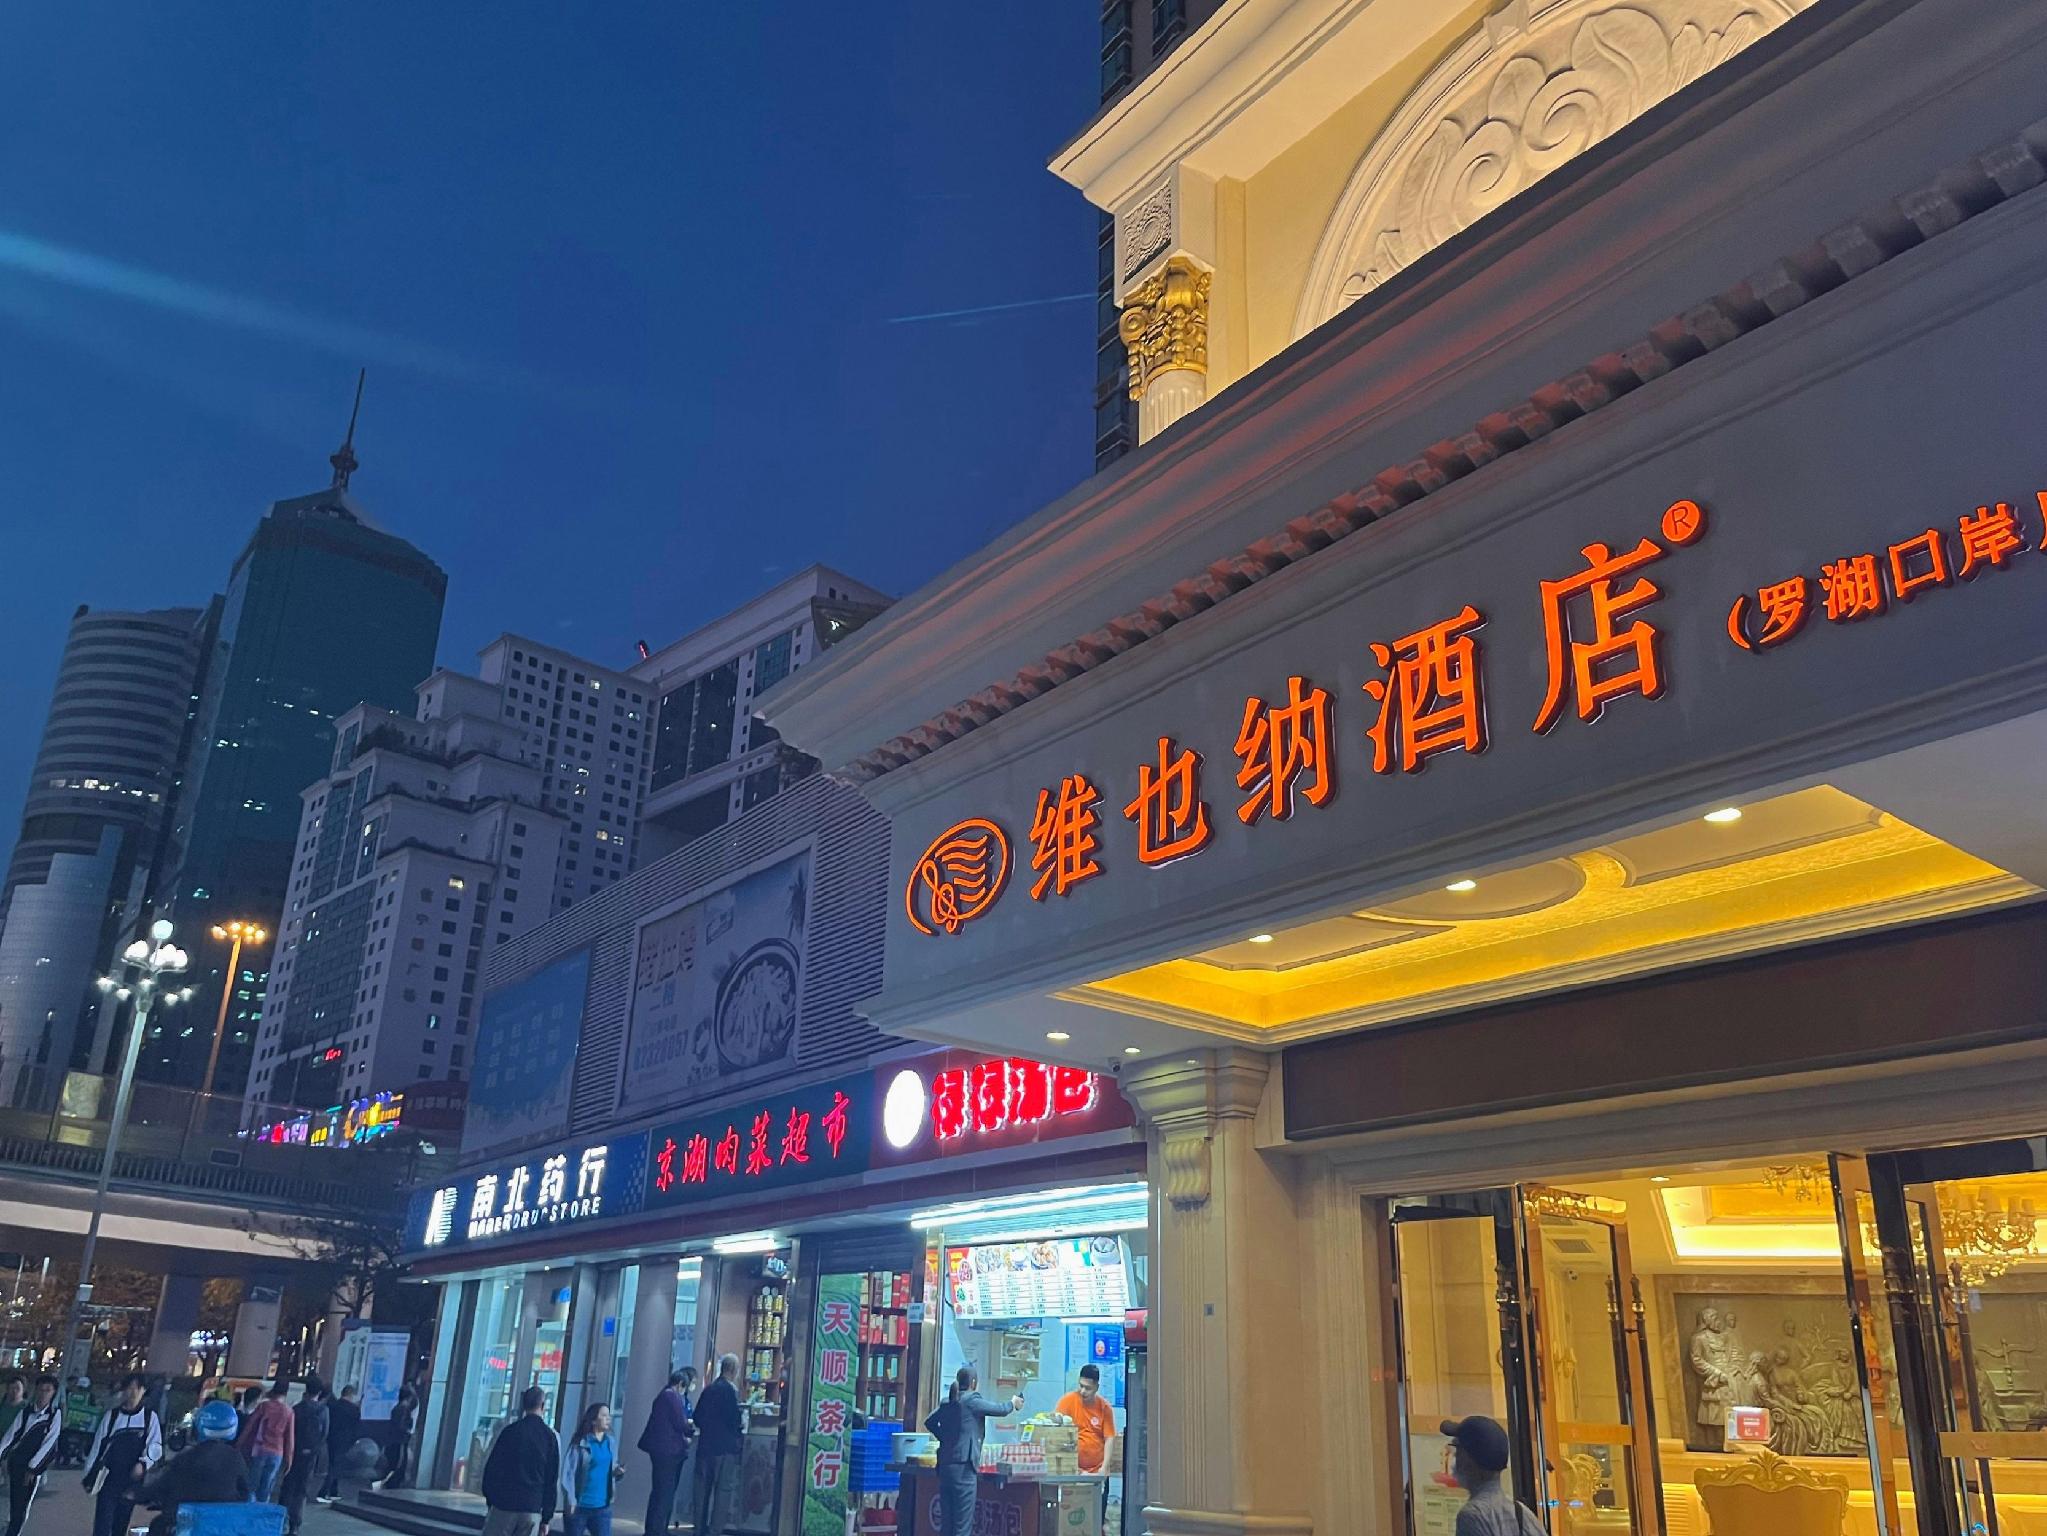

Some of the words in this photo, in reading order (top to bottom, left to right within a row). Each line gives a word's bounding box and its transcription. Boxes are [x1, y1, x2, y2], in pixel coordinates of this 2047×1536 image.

[1727, 490, 2047, 650] (罗湖口岸
[1029, 538, 1662, 901] 维也纳酒店
[469, 1145, 608, 1221] 南北药行
[656, 1090, 850, 1192] 京湖肉菜超市
[813, 1302, 852, 1489] 天顺茶行
